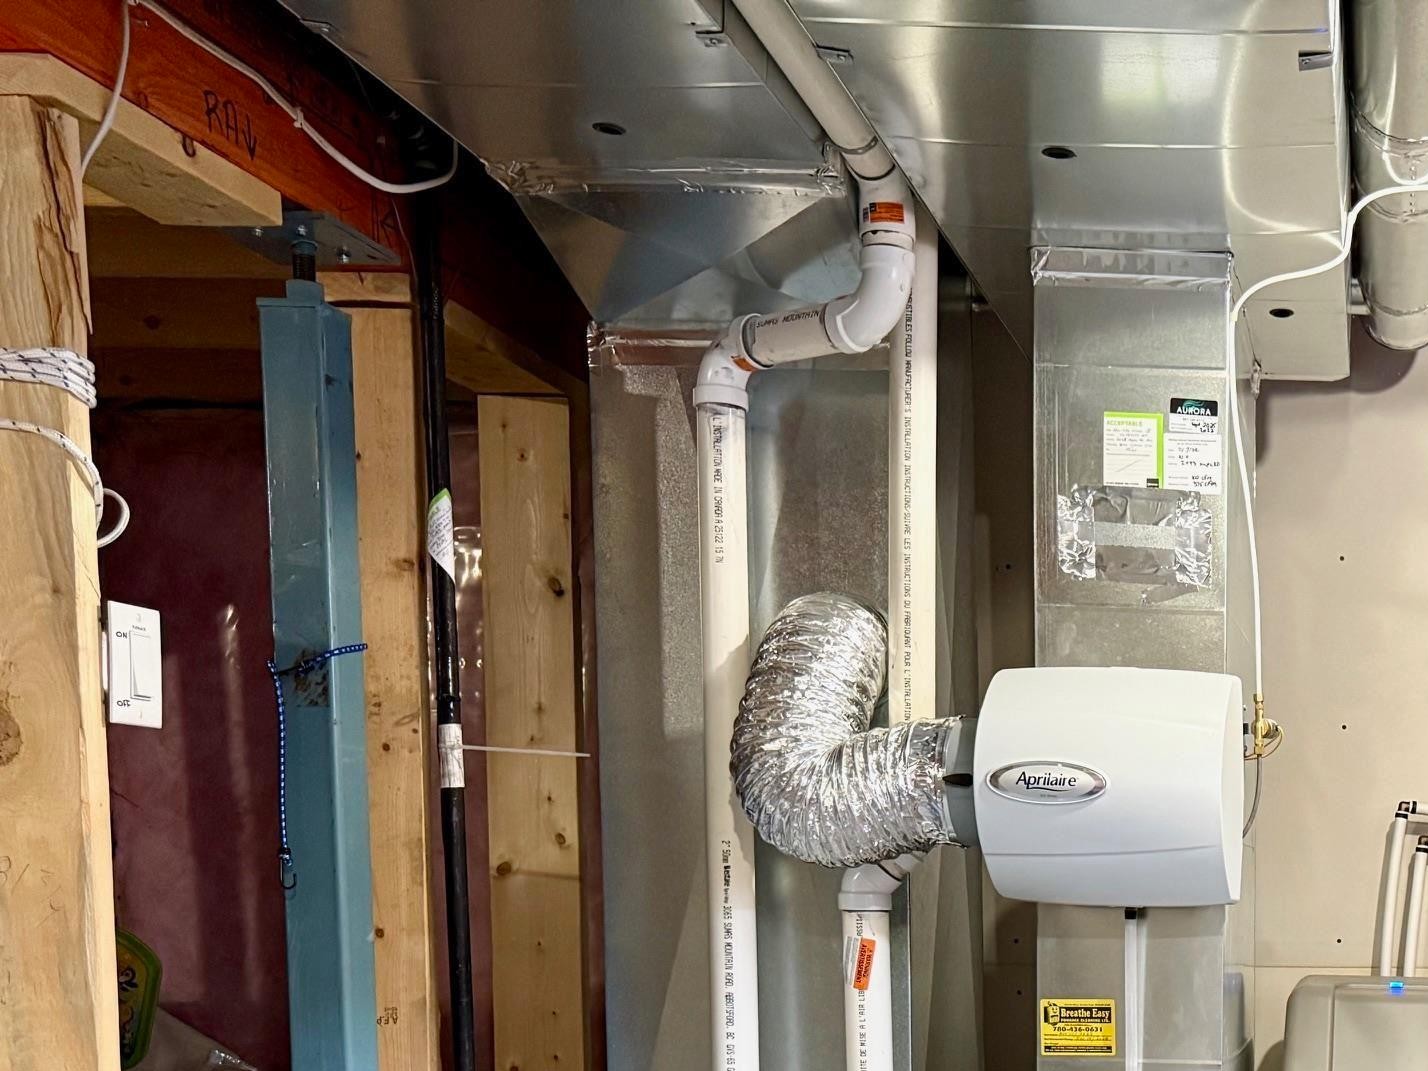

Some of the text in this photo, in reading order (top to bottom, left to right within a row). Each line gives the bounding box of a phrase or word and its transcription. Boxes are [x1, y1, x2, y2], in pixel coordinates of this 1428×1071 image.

[782, 310, 820, 323] MOUNTAIN
[904, 334, 913, 358] FOLLOW
[1176, 406, 1212, 416] AURORA
[904, 416, 912, 462] INSTALLATION
[714, 486, 723, 494] IN
[714, 496, 724, 518] CANADA
[904, 538, 912, 550] LES
[904, 554, 912, 598] INSTRUCTIONS
[116, 631, 128, 639] ON
[904, 651, 912, 667] POUR
[116, 699, 131, 707] OFF
[1016, 771, 1078, 790] Aprilaire
[723, 922, 733, 940] SUMAS
[724, 942, 734, 970] MOUNTAIN
[857, 991, 866, 1002] LIB
[1060, 1008, 1110, 1018] Breathe Easy
[858, 1032, 867, 1047] MISE
[859, 1049, 867, 1057] DE
